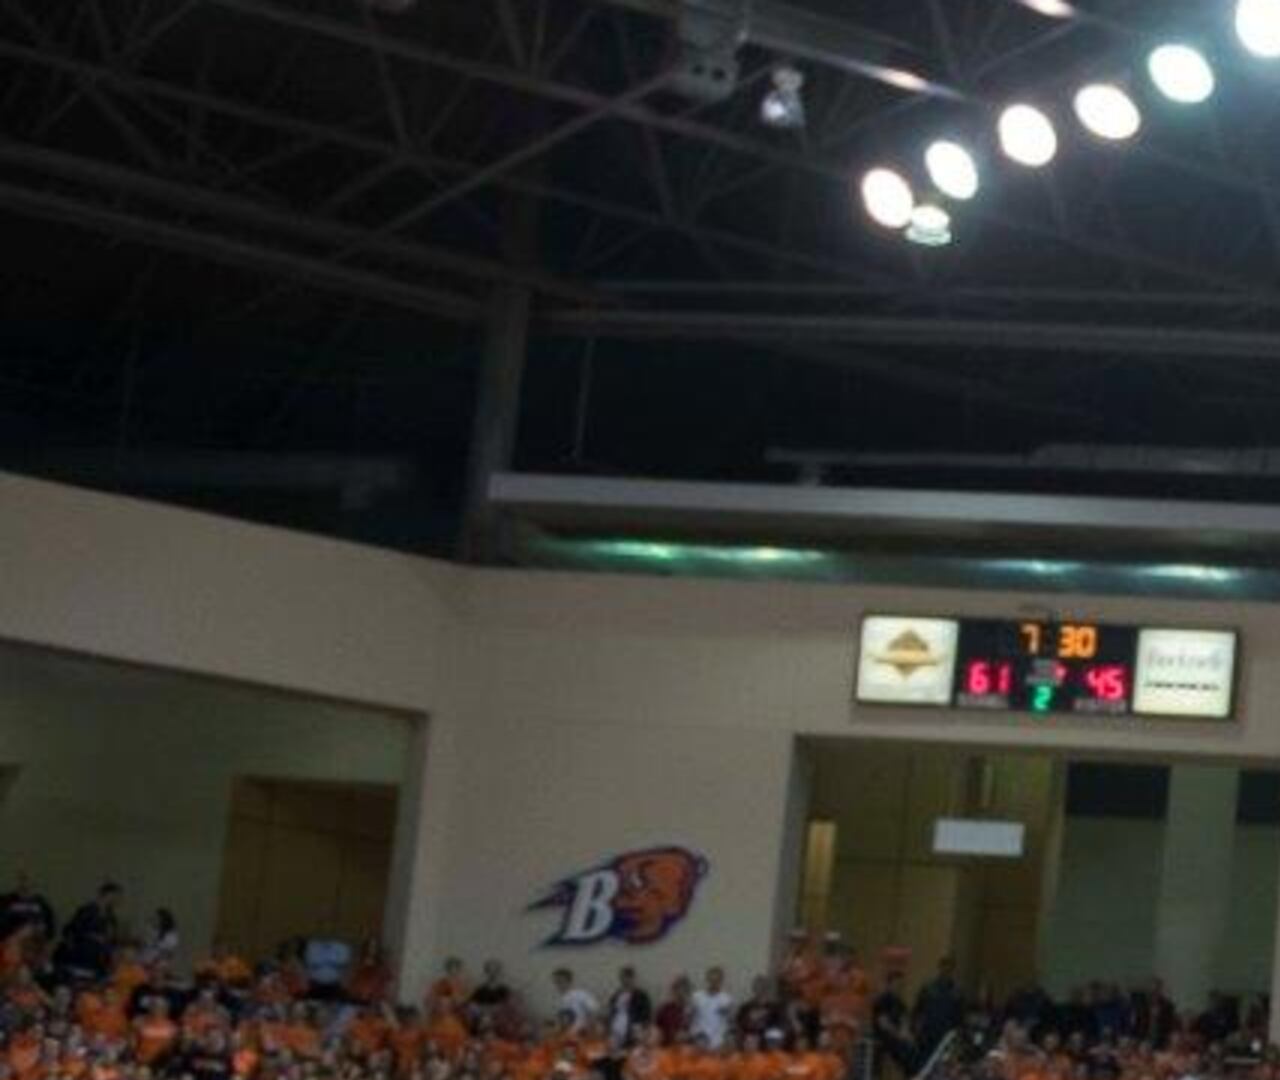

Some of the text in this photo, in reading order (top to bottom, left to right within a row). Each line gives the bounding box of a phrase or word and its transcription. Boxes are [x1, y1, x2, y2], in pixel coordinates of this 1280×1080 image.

[1057, 625, 1098, 658] 30
[968, 660, 1010, 695] 61
[1085, 664, 1126, 700] 45
[1033, 683, 1053, 711] 2
